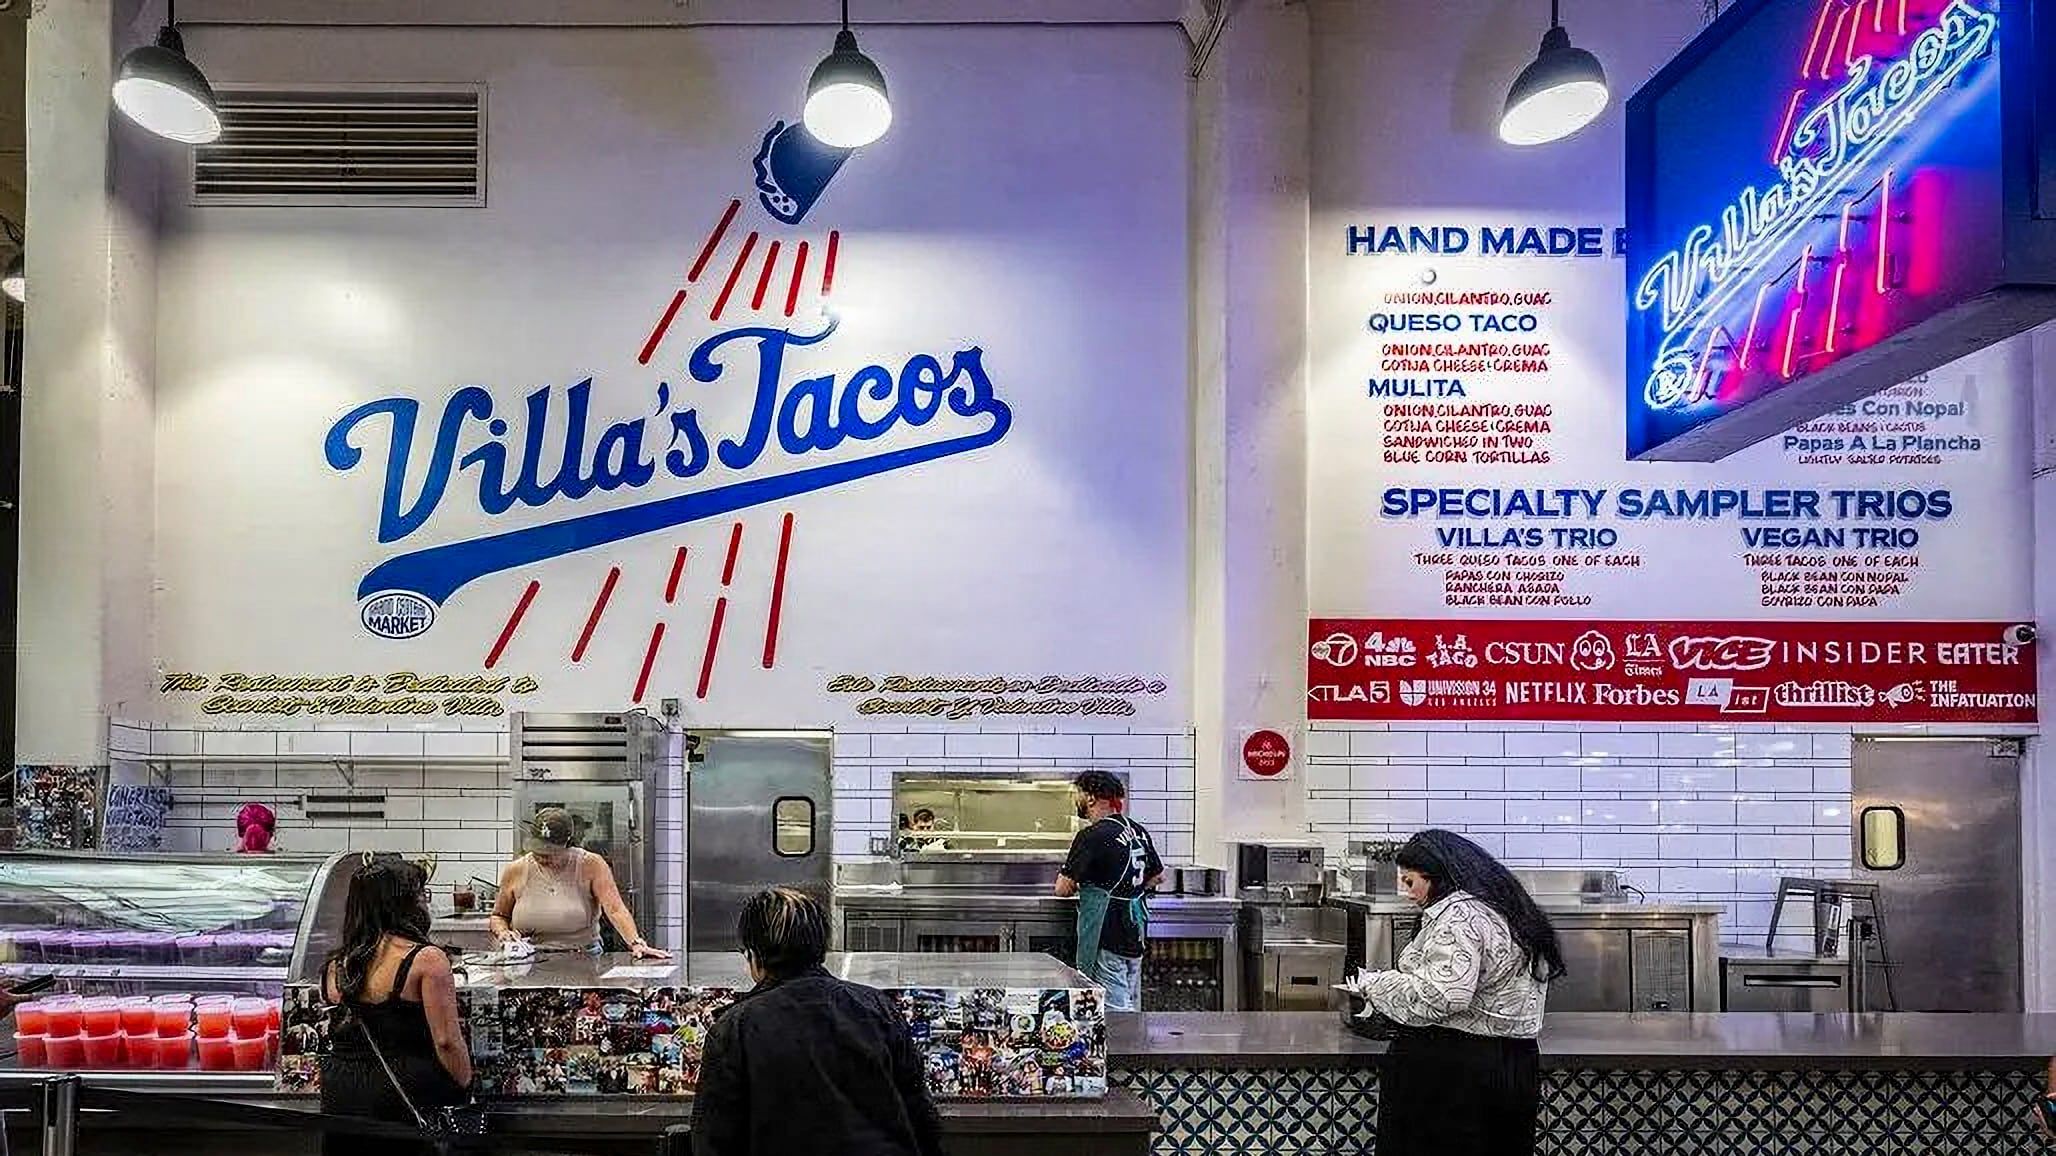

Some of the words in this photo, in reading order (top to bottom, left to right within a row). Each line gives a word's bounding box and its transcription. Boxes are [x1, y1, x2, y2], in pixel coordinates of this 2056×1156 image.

[1348, 225, 1470, 256] HAND
[1479, 226, 1603, 257] MADE
[1369, 314, 1461, 333] QUESO
[1469, 315, 1537, 332] TACO
[1369, 378, 1466, 397] MULITA
[1862, 401, 1900, 416] Con
[1905, 401, 1965, 419] Nopal
[324, 376, 706, 544] Villa's
[689, 314, 1003, 470] Tacos
[1383, 435, 1478, 448] SANDWICHED
[1482, 435, 1499, 448] IN
[1501, 435, 1533, 448] TWO
[1784, 436, 1845, 452] Papas
[1849, 436, 1868, 450] A
[1871, 435, 1898, 450] La
[1902, 435, 1981, 450] Plancha
[1383, 450, 1420, 463] BLUE
[1425, 450, 1467, 463] CORN
[1473, 450, 1551, 464] TORTILLAS
[1382, 488, 1606, 519] SPECIALTY
[1616, 488, 1821, 519] SAMPLER
[1831, 489, 1953, 519] TRIOS
[1437, 527, 1544, 547] VILLA'S
[1550, 527, 1618, 547] TRIO
[1742, 527, 1845, 548] VEGAN
[1852, 527, 1919, 548] TRIO
[1415, 554, 1453, 566] THREE
[1505, 554, 1546, 566] TACOS
[1552, 554, 1579, 566] ONE
[1584, 554, 1600, 566] OF
[1605, 554, 1641, 567] EACH
[1744, 555, 1782, 567] THREE
[1785, 555, 1827, 567] TACOS
[1832, 555, 1858, 567] ONE
[1864, 555, 1880, 567] OF
[1884, 555, 1919, 567] EACH
[1446, 571, 1484, 581] PAPAS
[1486, 571, 1511, 581] CON
[1761, 572, 1800, 582] BLACK
[1804, 572, 1838, 582] BEAN
[1840, 572, 1866, 582] CON
[1867, 572, 1909, 582] NOPAL
[1446, 582, 1513, 593] RANCHERA
[1518, 583, 1560, 594] ASADA
[1761, 584, 1800, 594] BLACK
[1804, 584, 1838, 594] BEAN
[1840, 584, 1866, 594] CON
[1446, 595, 1485, 606] BLACK
[1489, 595, 1523, 606] BEAN
[1524, 595, 1551, 606] CON
[1817, 596, 1845, 607] CON
[368, 615, 427, 635] MARKET
[1364, 631, 1384, 652] 4
[1624, 633, 1662, 657] LA
[1364, 654, 1416, 667] NBC
[1425, 650, 1479, 668] TACO
[1485, 641, 1565, 665] CSUN
[1669, 636, 1777, 670] VICE
[1783, 642, 1927, 664] INSIDER
[1937, 642, 2020, 665] EATER
[1482, 680, 1497, 695] 34
[1505, 682, 1586, 705] NETFLIX
[1592, 683, 1680, 706] Forbes
[1696, 686, 1720, 699] LA
[1774, 681, 1875, 707] thrillist
[1929, 680, 1957, 693] THE
[1929, 693, 2036, 708] INFATUATION
